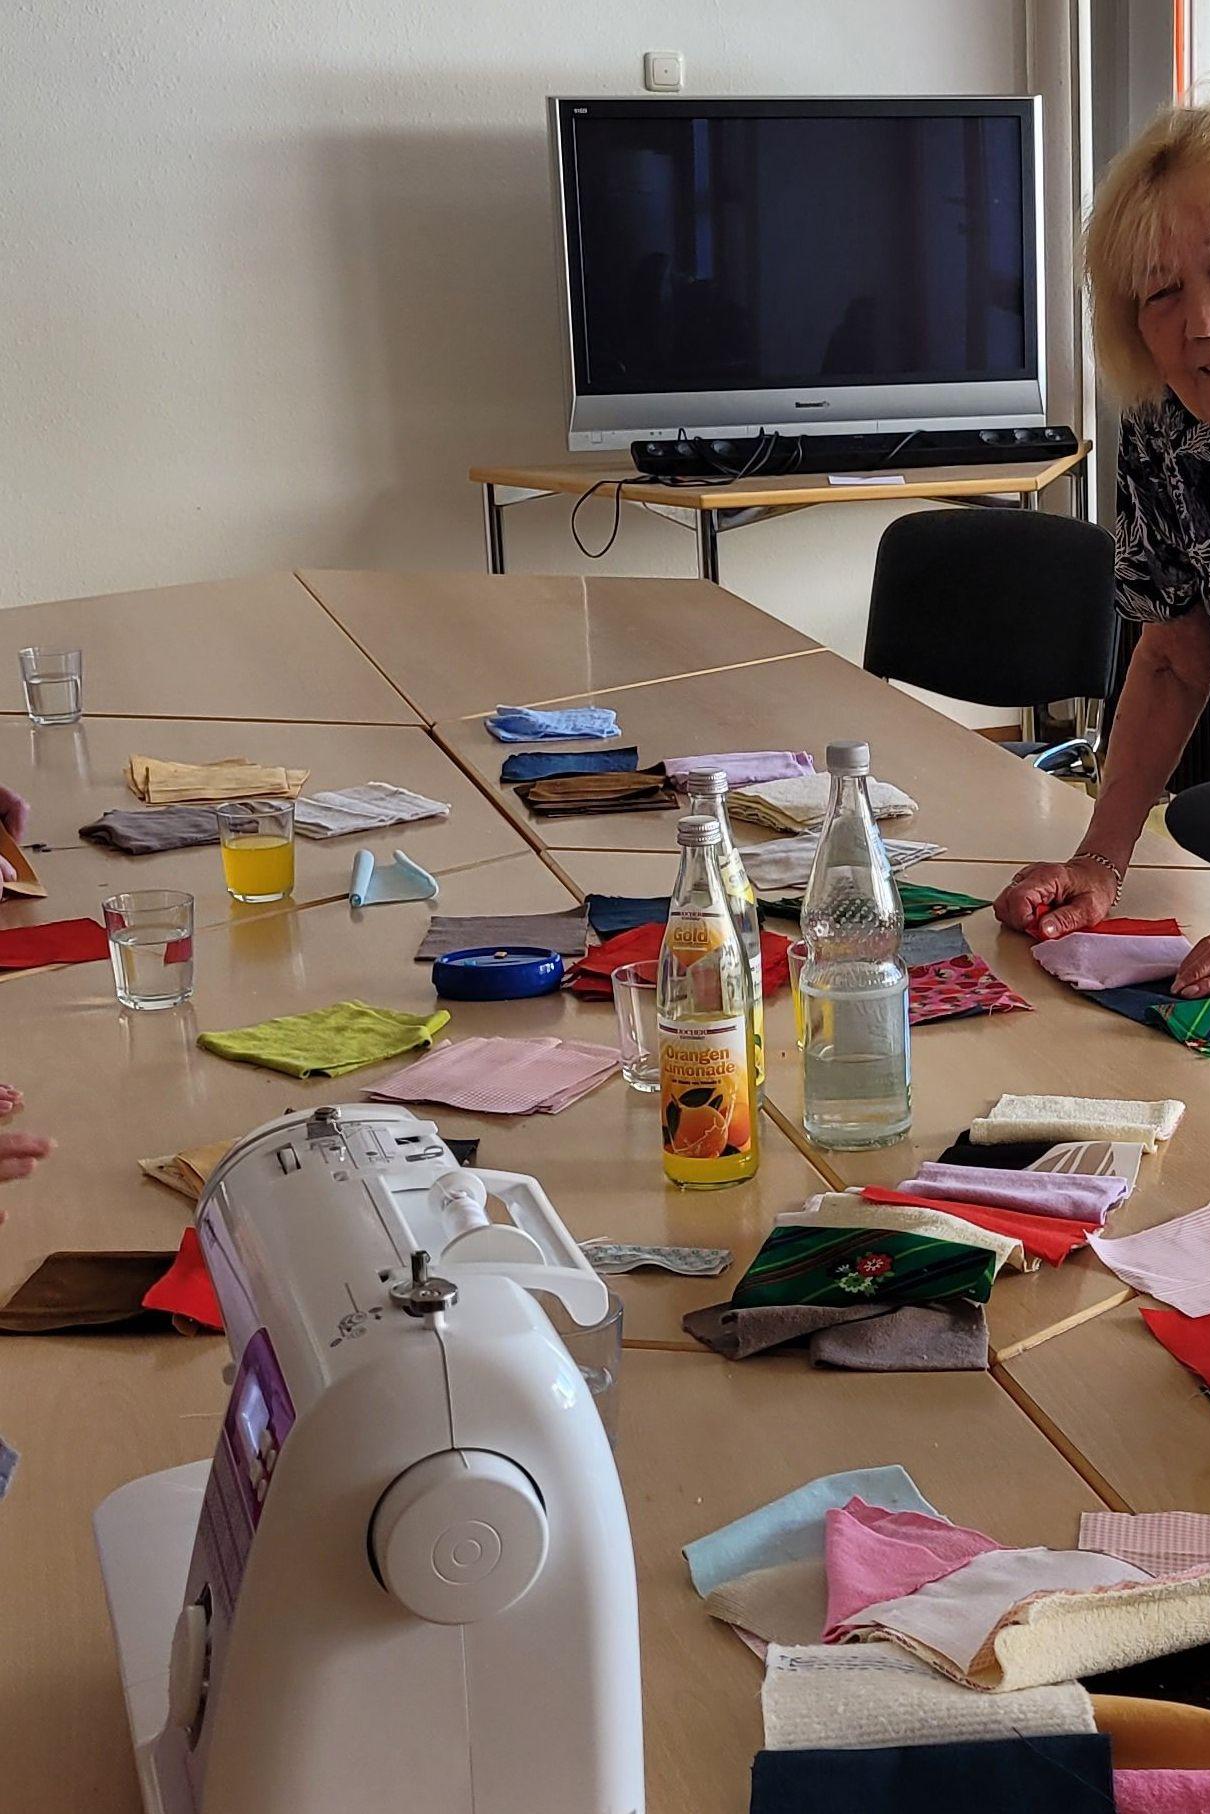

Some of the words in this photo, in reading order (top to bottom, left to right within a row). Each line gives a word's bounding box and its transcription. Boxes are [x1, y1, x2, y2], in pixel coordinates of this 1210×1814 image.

[674, 927, 708, 943] Gold
[665, 1045, 730, 1065] Orangen
[664, 1062, 735, 1078] Limonade
